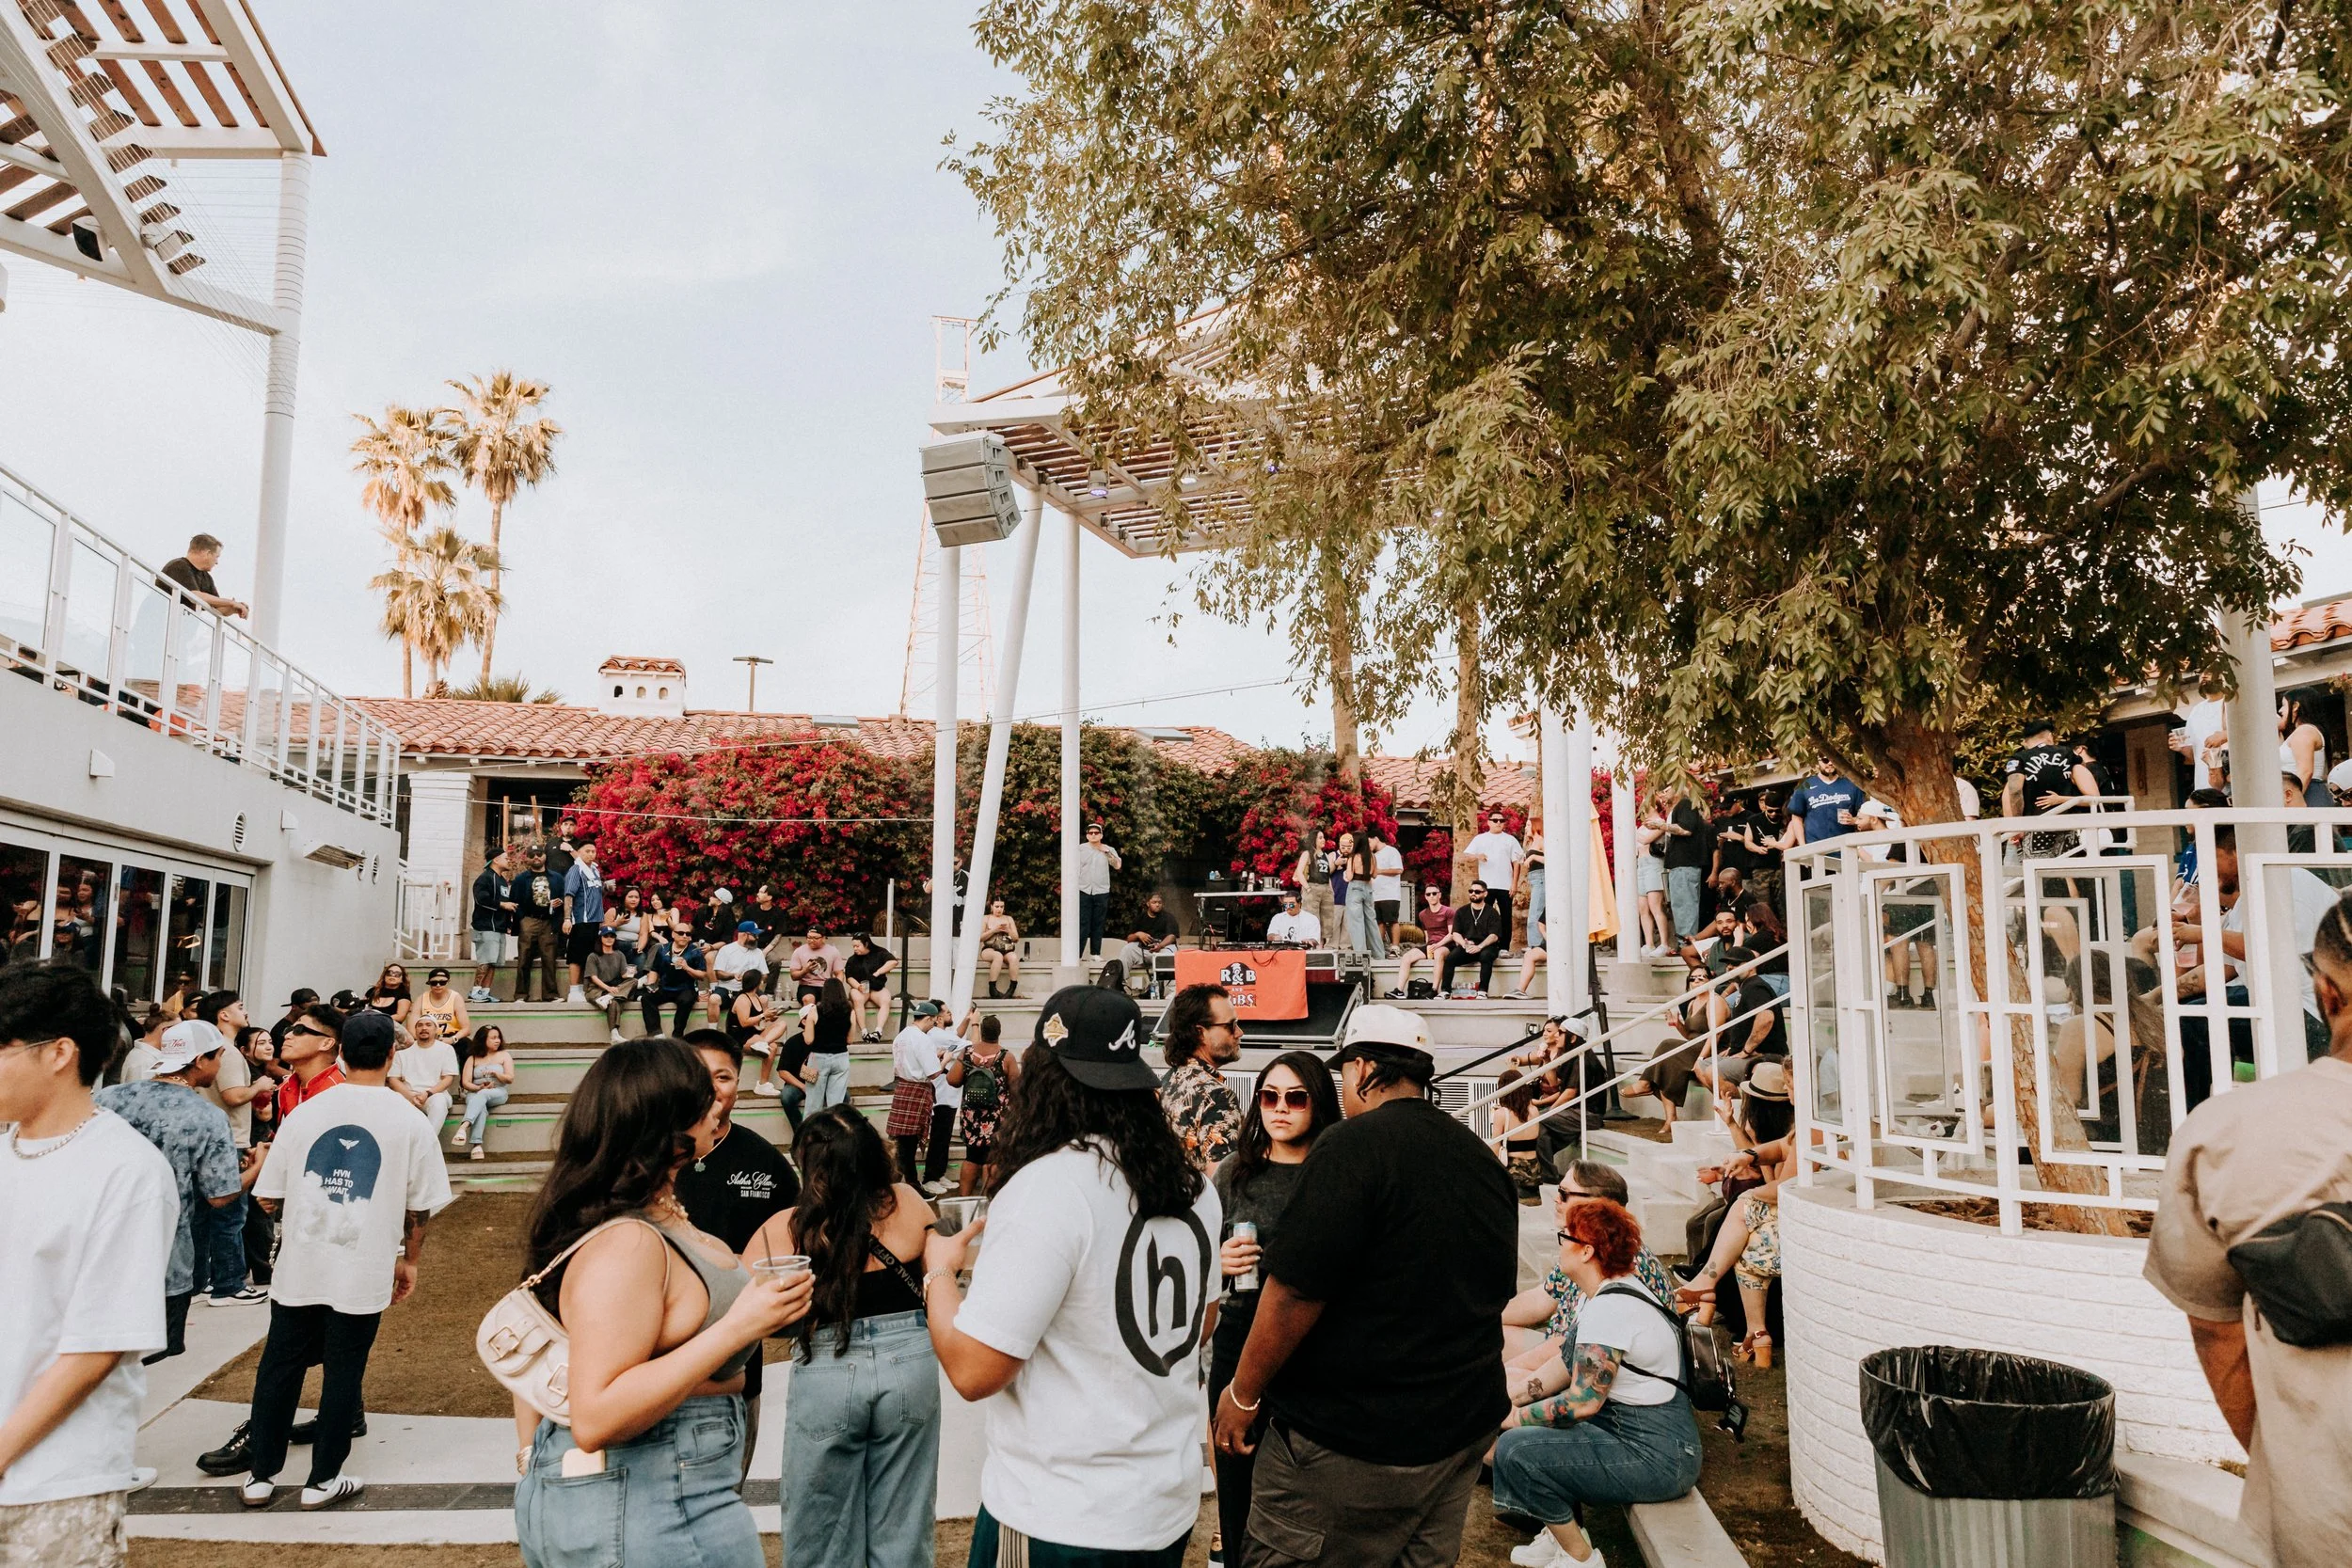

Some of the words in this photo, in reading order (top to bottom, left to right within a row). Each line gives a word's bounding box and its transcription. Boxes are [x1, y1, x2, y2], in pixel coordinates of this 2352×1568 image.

[2025, 753, 2073, 782] SUPREME
[1819, 792, 1851, 804] Dodgers
[1318, 863, 1328, 873] 22
[1220, 968, 1257, 985] R&B
[438, 1022, 448, 1034] 7
[1108, 1019, 1136, 1052] A
[332, 1168, 351, 1179] HVN
[324, 1177, 343, 1186] HAS
[343, 1179, 354, 1189] TO
[328, 1185, 349, 1195] WAIT
[740, 1189, 750, 1198] SAN
[750, 1190, 771, 1200] FRANCISCO
